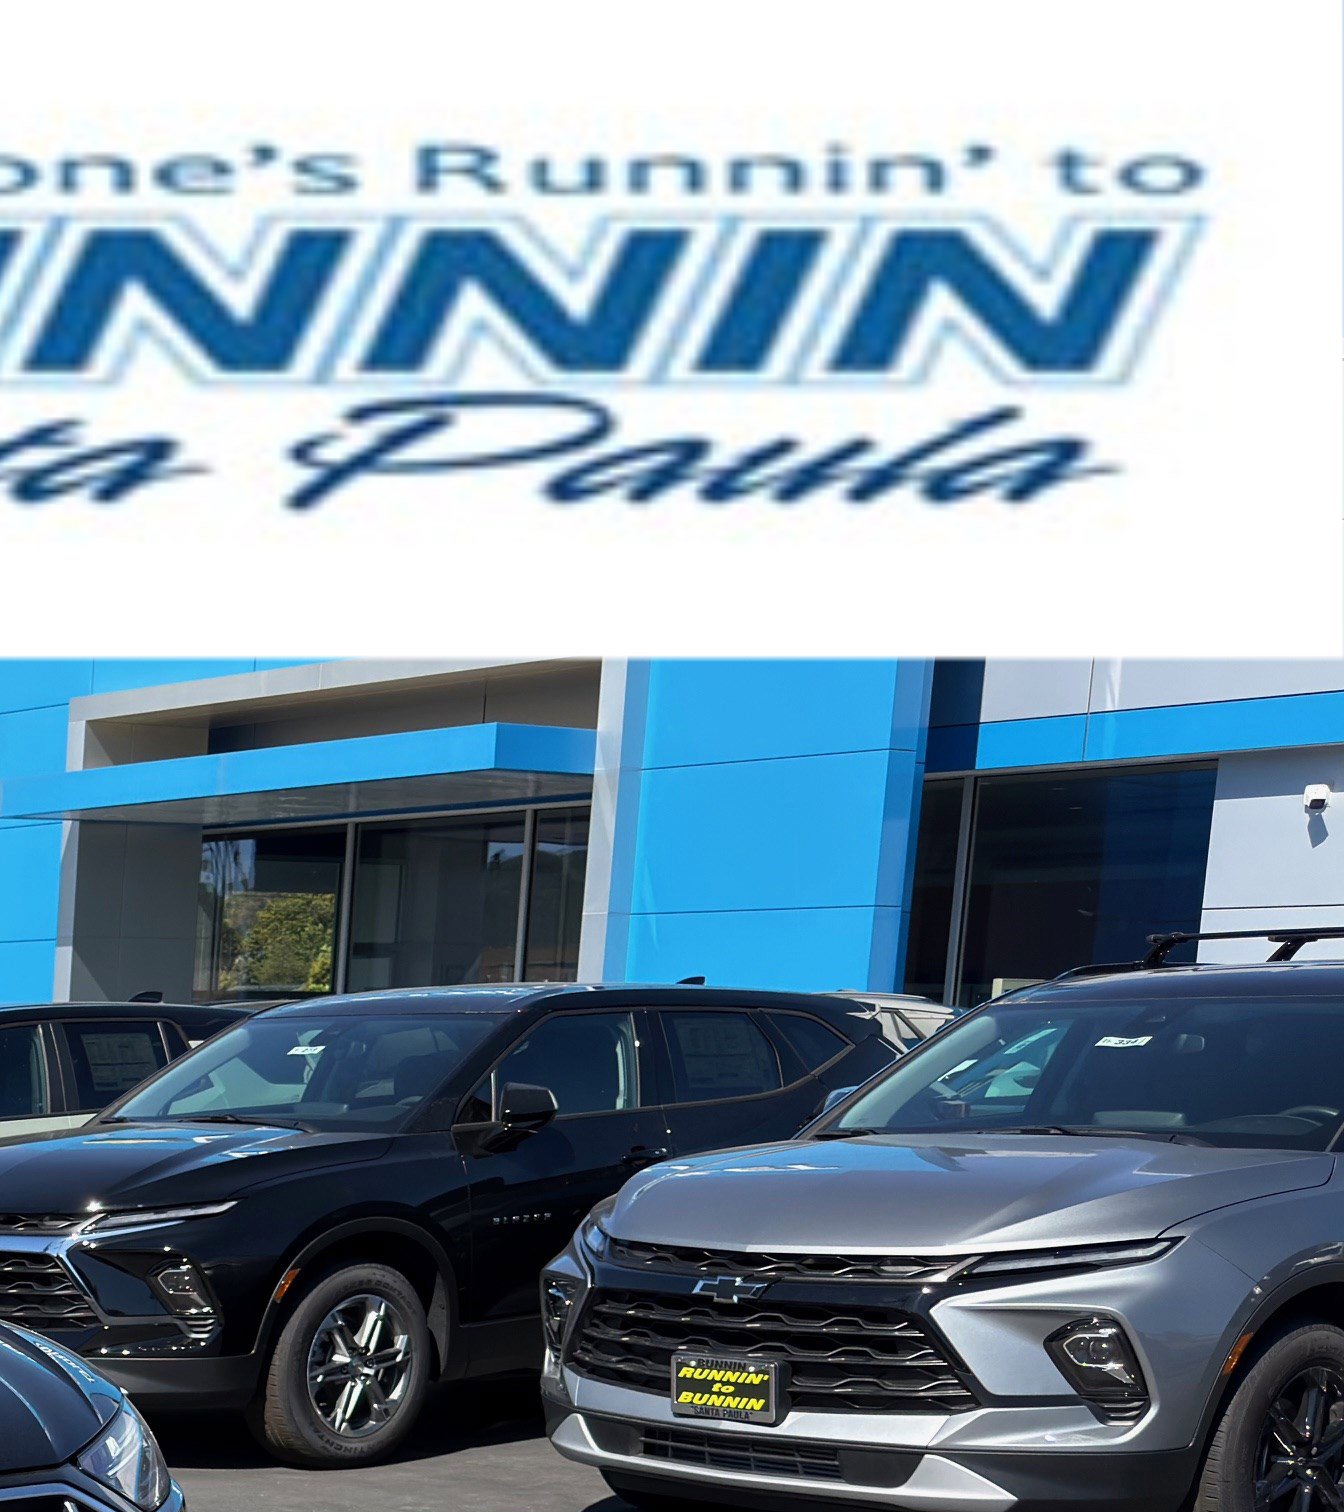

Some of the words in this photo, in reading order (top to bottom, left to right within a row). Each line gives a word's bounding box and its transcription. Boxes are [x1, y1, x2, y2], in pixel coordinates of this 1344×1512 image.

[697, 1358, 747, 1371] BUNNIN
[677, 1366, 770, 1385] RUNNIN'
[711, 1382, 736, 1393] to
[677, 1391, 766, 1411] BUNNIN
